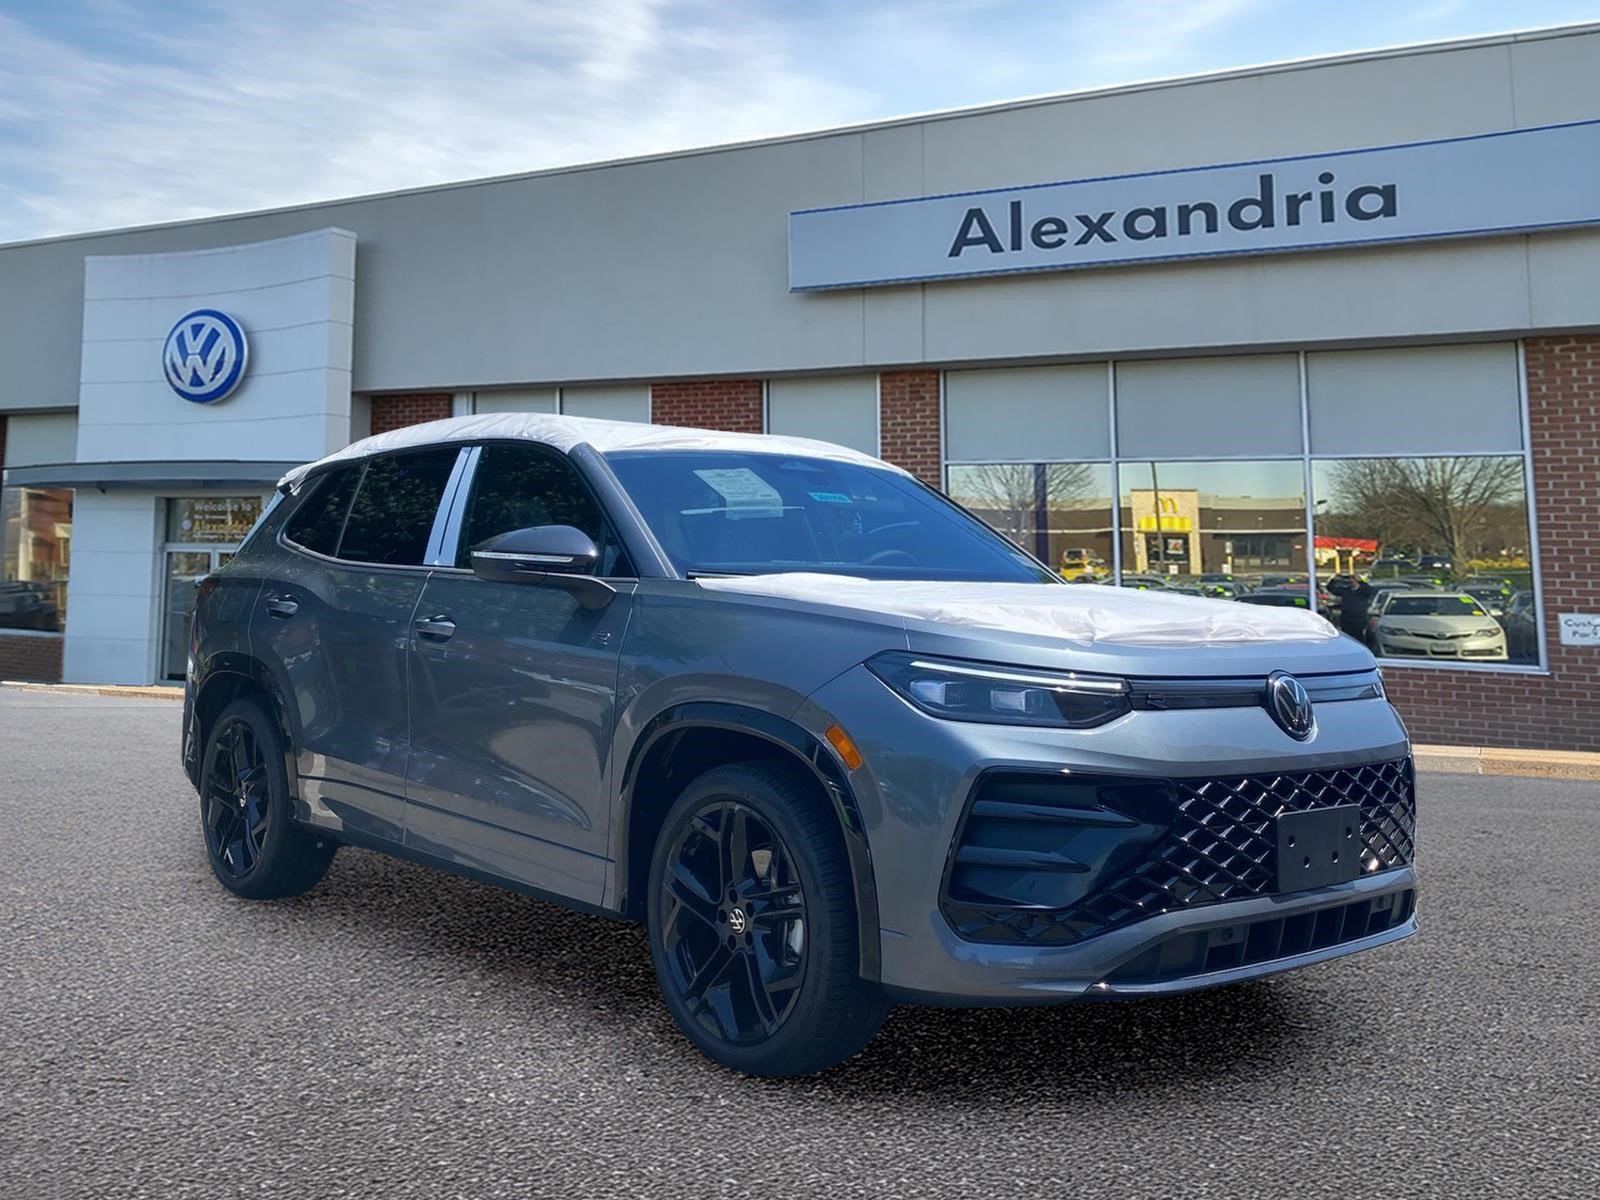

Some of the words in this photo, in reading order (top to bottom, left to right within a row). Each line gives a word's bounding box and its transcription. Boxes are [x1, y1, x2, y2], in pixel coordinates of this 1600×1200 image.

[947, 172, 1397, 258] Alexandria
[194, 502, 240, 511] Welcome
[241, 503, 252, 511] to
[193, 520, 253, 533] Alexandri
